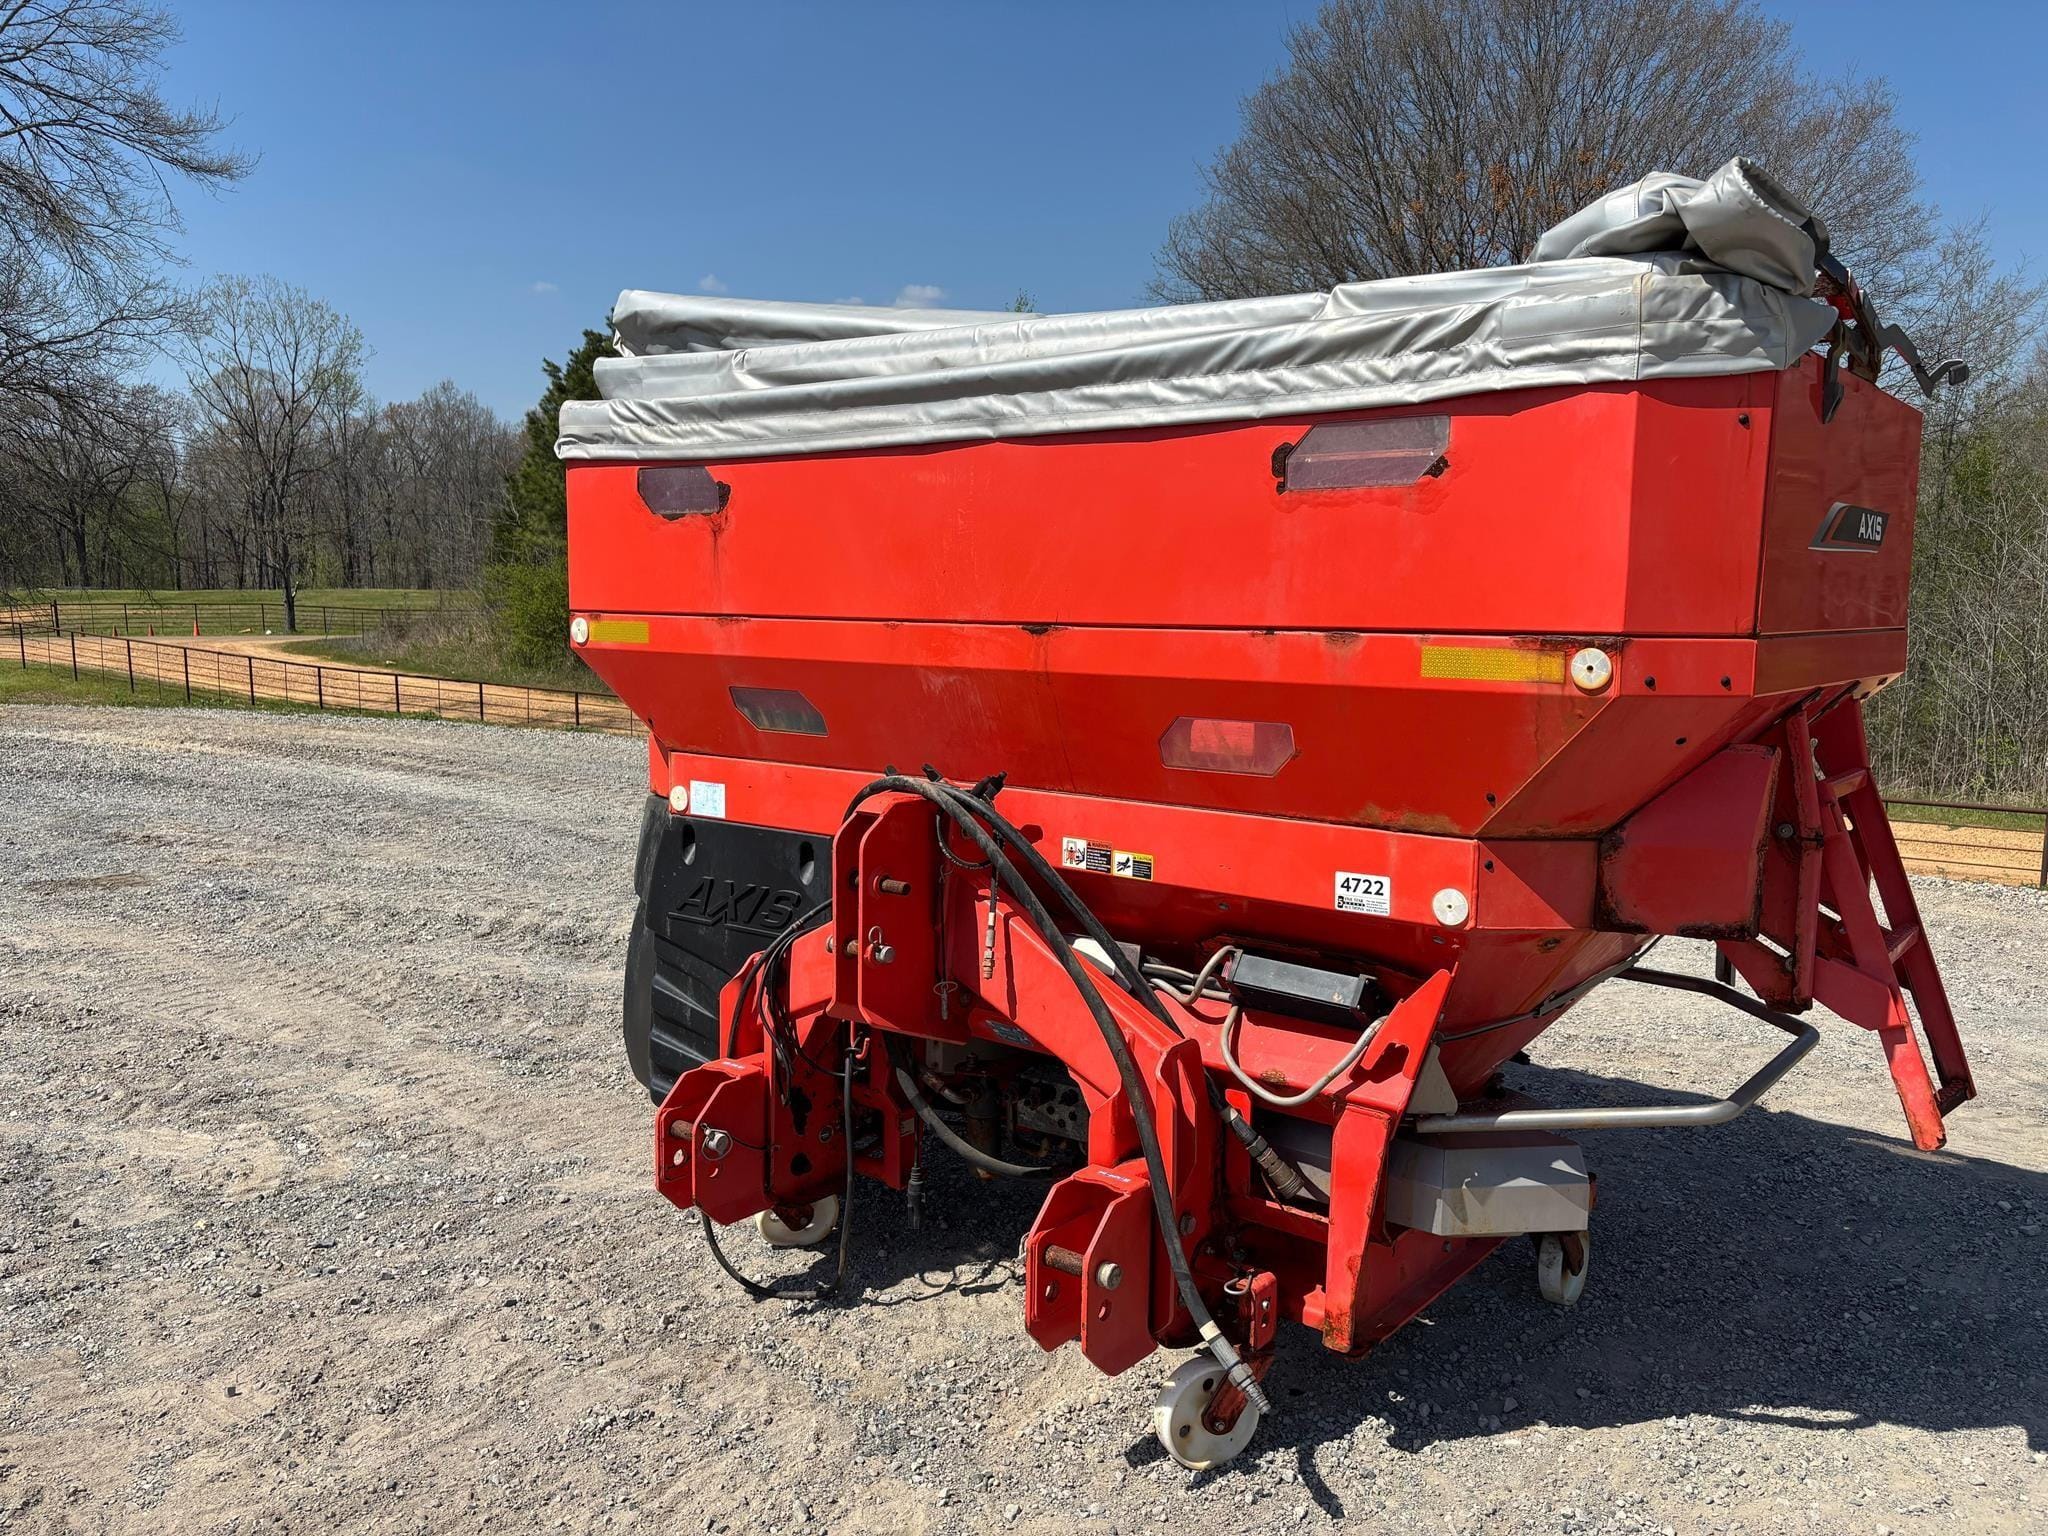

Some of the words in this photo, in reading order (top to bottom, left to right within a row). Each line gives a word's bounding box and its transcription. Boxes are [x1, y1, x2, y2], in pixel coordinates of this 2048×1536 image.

[1858, 512, 1882, 541] AXIS
[1340, 877, 1384, 896] 4722
[676, 876, 802, 930] AXIS
